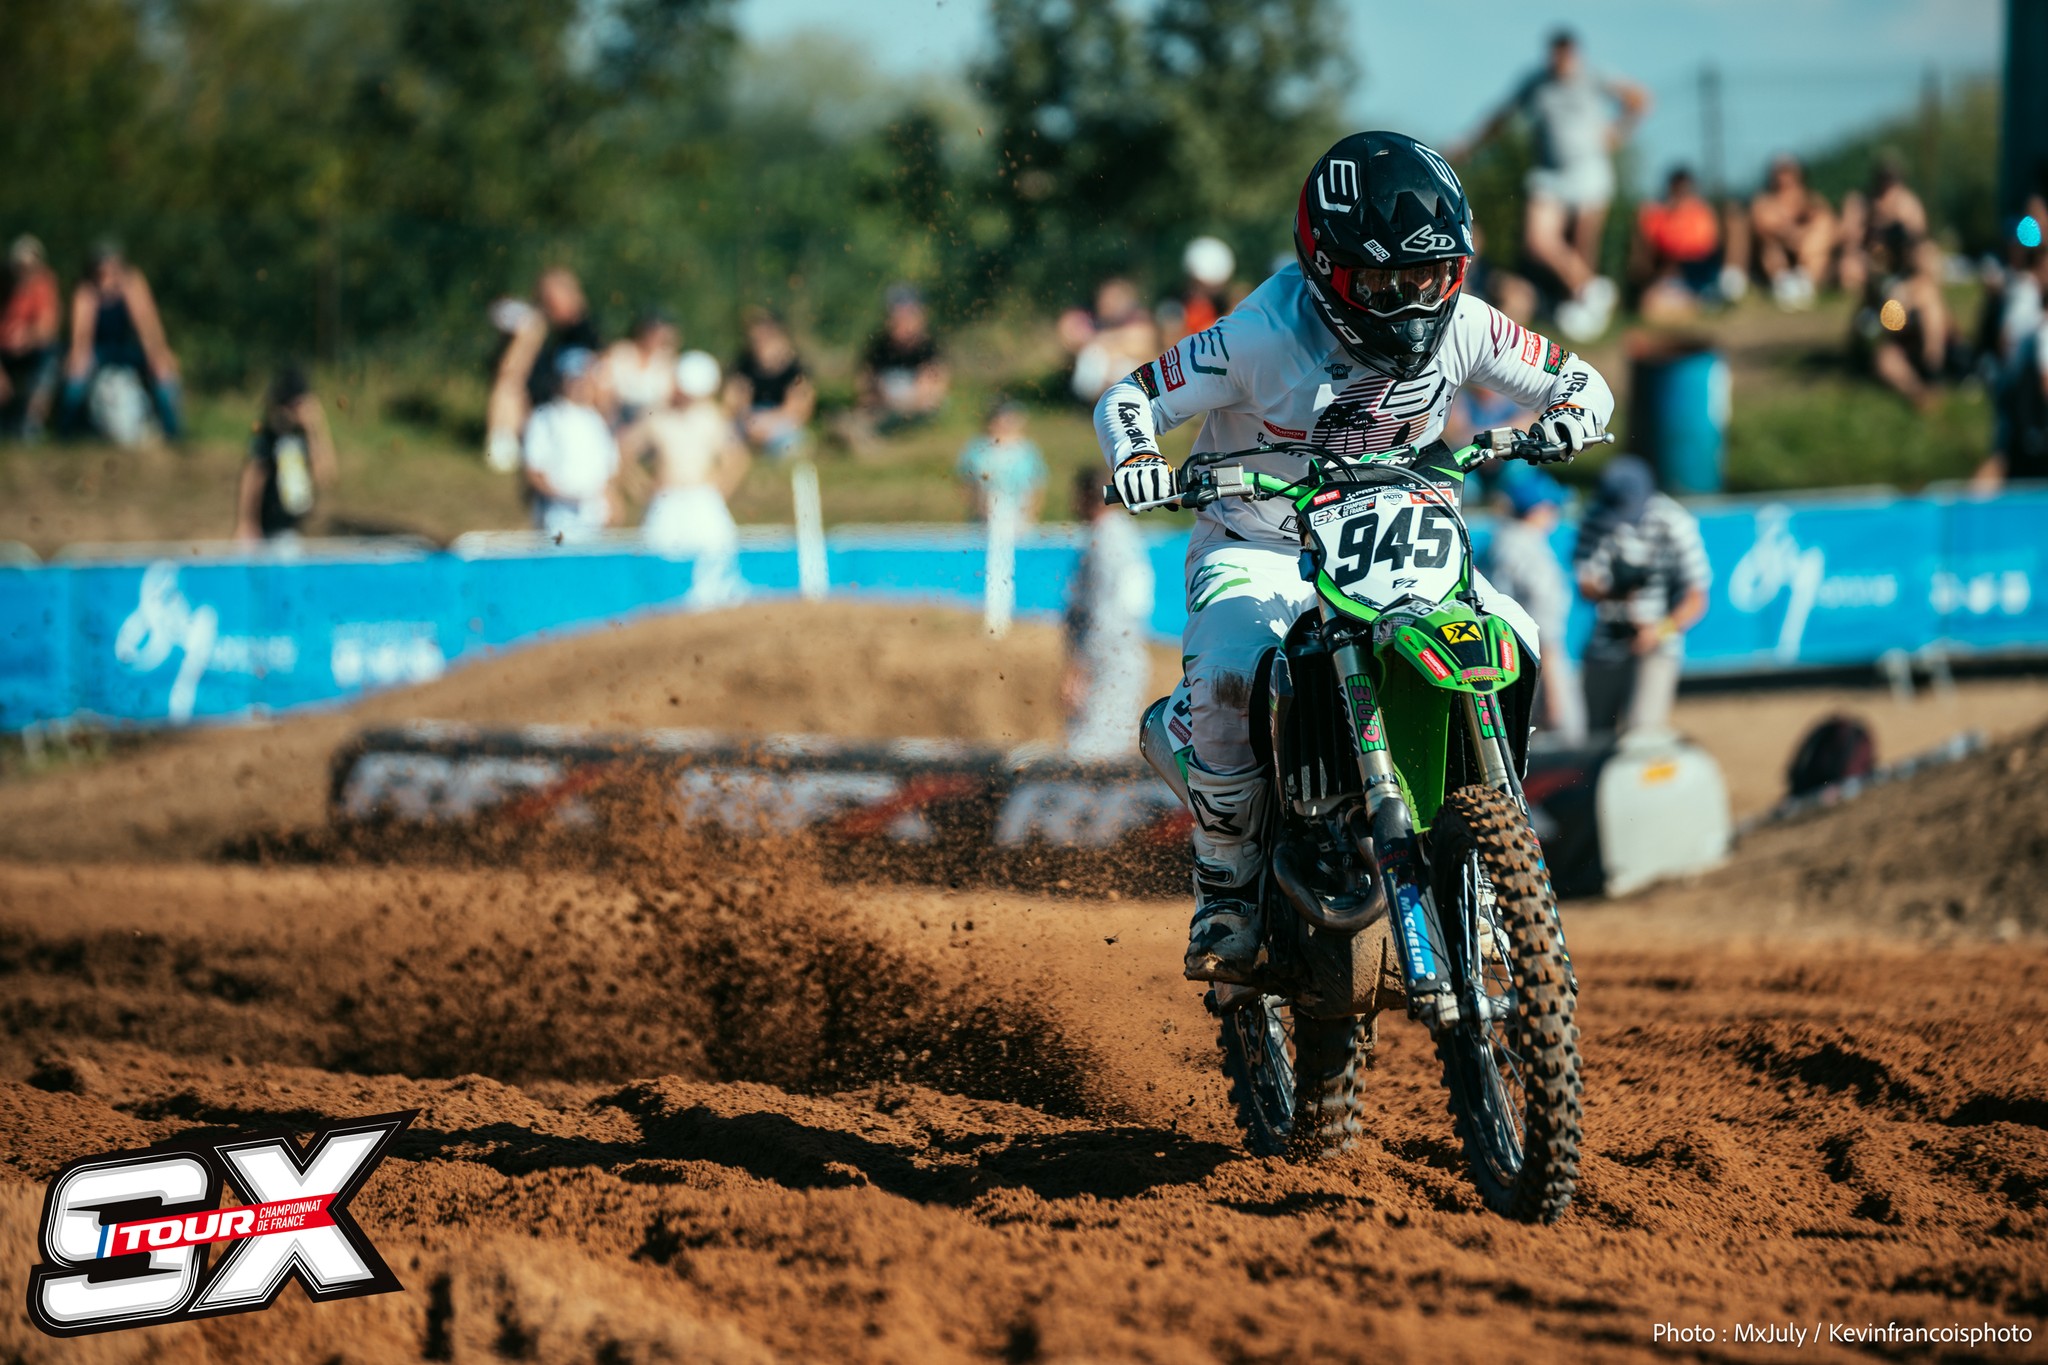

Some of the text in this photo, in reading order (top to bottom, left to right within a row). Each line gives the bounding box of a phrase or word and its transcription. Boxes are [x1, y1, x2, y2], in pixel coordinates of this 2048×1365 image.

[1313, 506, 1343, 527] SX
[1334, 506, 1453, 588] 945
[1352, 684, 1381, 743] BUD
[1400, 896, 1426, 975] MICHELIN
